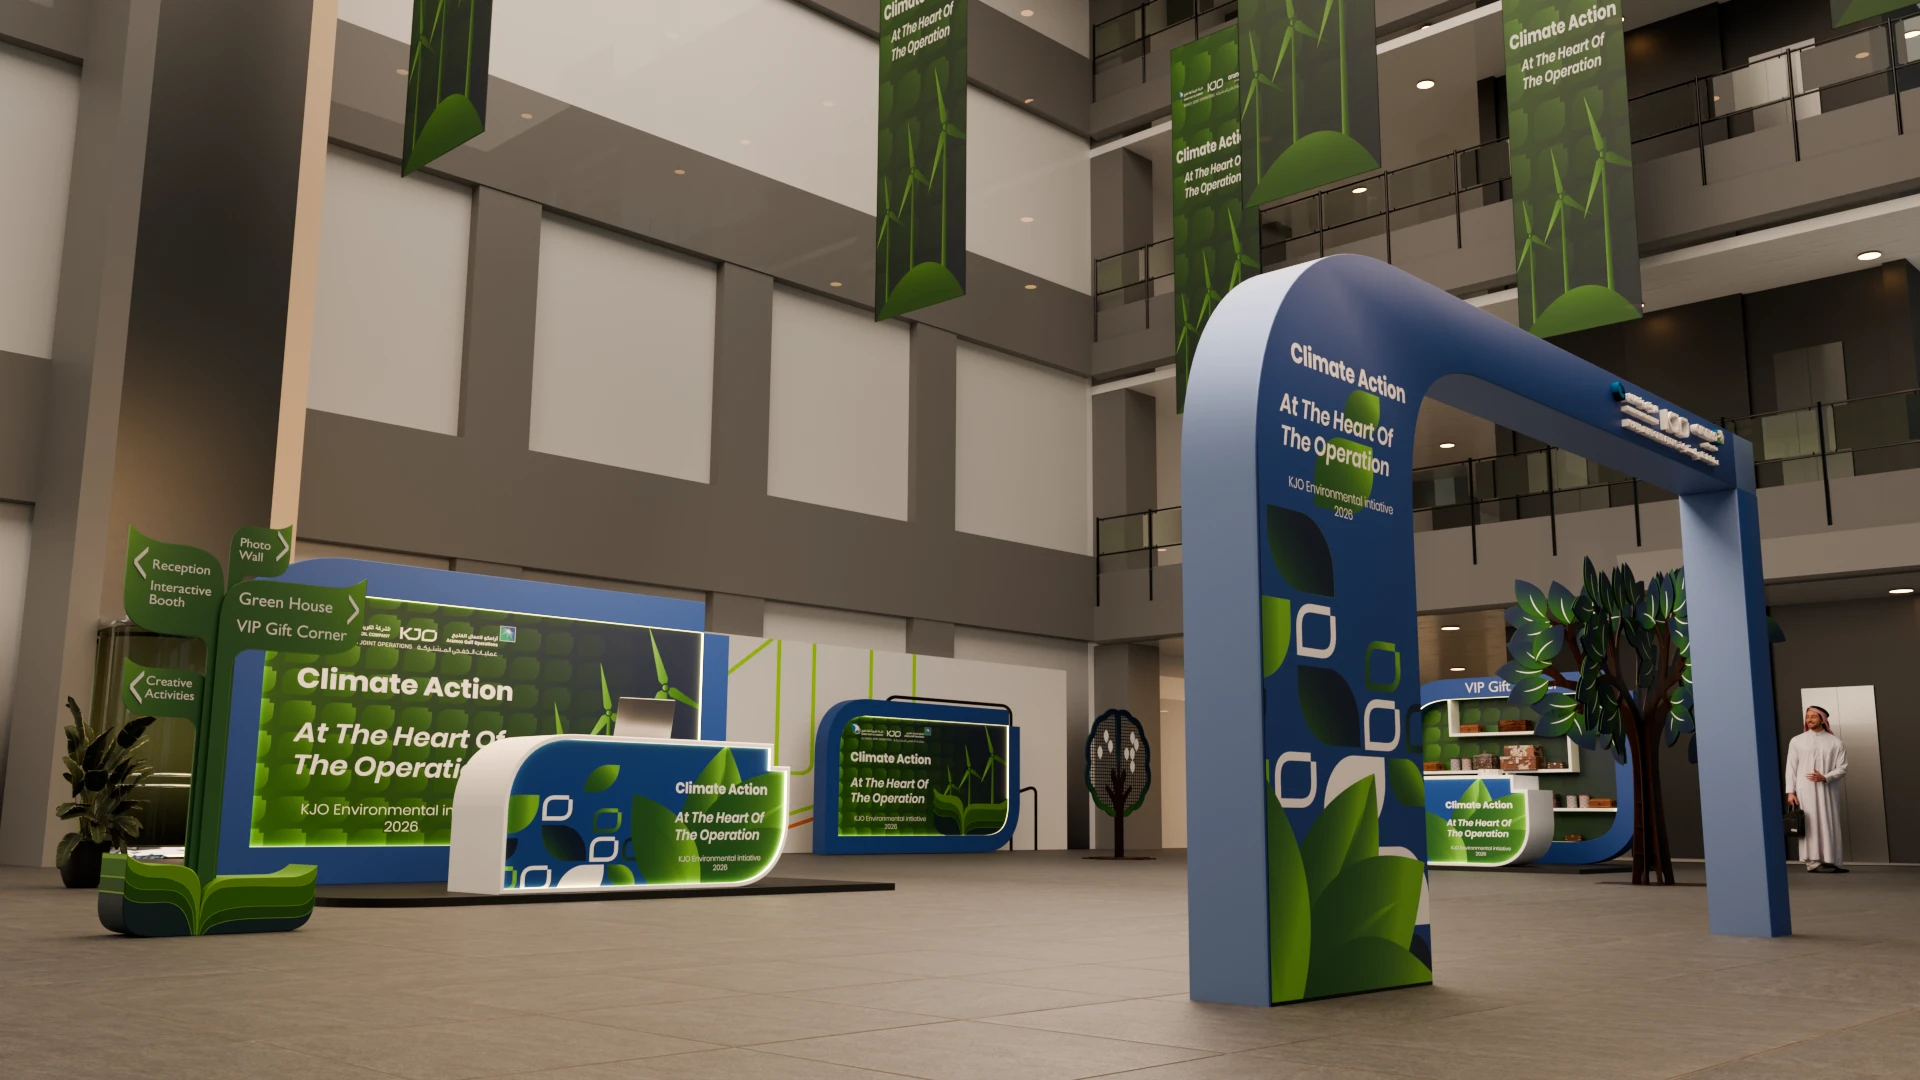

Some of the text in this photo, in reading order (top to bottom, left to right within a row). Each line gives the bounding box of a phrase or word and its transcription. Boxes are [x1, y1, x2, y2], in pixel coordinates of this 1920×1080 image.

[884, 0, 925, 20] Clima
[891, 0, 954, 43] At The Heart Of
[1509, 3, 1616, 50] Climate Action
[891, 26, 950, 61] The Operation
[1521, 32, 1605, 72] At The Heart Of
[1523, 56, 1602, 90] The Operation
[1176, 129, 1241, 164] Climate Acti
[1184, 155, 1241, 183] At The Heart O
[1185, 172, 1241, 198] The Operation
[1290, 342, 1406, 404] Climate Action
[1280, 392, 1394, 448] At The Heart Of
[1282, 424, 1389, 477] The Operation
[1288, 476, 1304, 490] KJO
[1306, 480, 1362, 506] Environmental
[1334, 506, 1354, 520] 2026
[240, 538, 271, 550] Photo
[239, 550, 263, 562] Wall
[152, 559, 210, 576] Reception
[150, 580, 212, 597] Interactive
[149, 594, 185, 608] Booth
[239, 592, 333, 614] Green House
[237, 619, 347, 642] VIP Gift Corner
[400, 626, 438, 642] KJO
[377, 641, 413, 649] OPERATIONS
[146, 676, 192, 688] Creative
[298, 667, 513, 701] Climate Action
[1465, 680, 1511, 694] VIP Gift
[144, 689, 194, 701] Activities
[293, 722, 329, 743] At
[337, 724, 388, 746] The
[393, 726, 470, 749] Heart
[850, 751, 932, 765] Climate Action
[294, 754, 462, 783] The Operati
[676, 781, 768, 795] Climate Action
[850, 778, 929, 789] At The Heart Of
[851, 792, 925, 806] The Operation
[1445, 800, 1513, 809] Climate Action
[301, 803, 329, 815] KJO
[334, 804, 438, 816] Environmental
[675, 812, 765, 824] At The Heart Of
[1446, 819, 1512, 827] At The Heart Of
[384, 821, 419, 832] 2026
[1447, 830, 1509, 839] The Operation
[675, 828, 760, 844] The Operation
